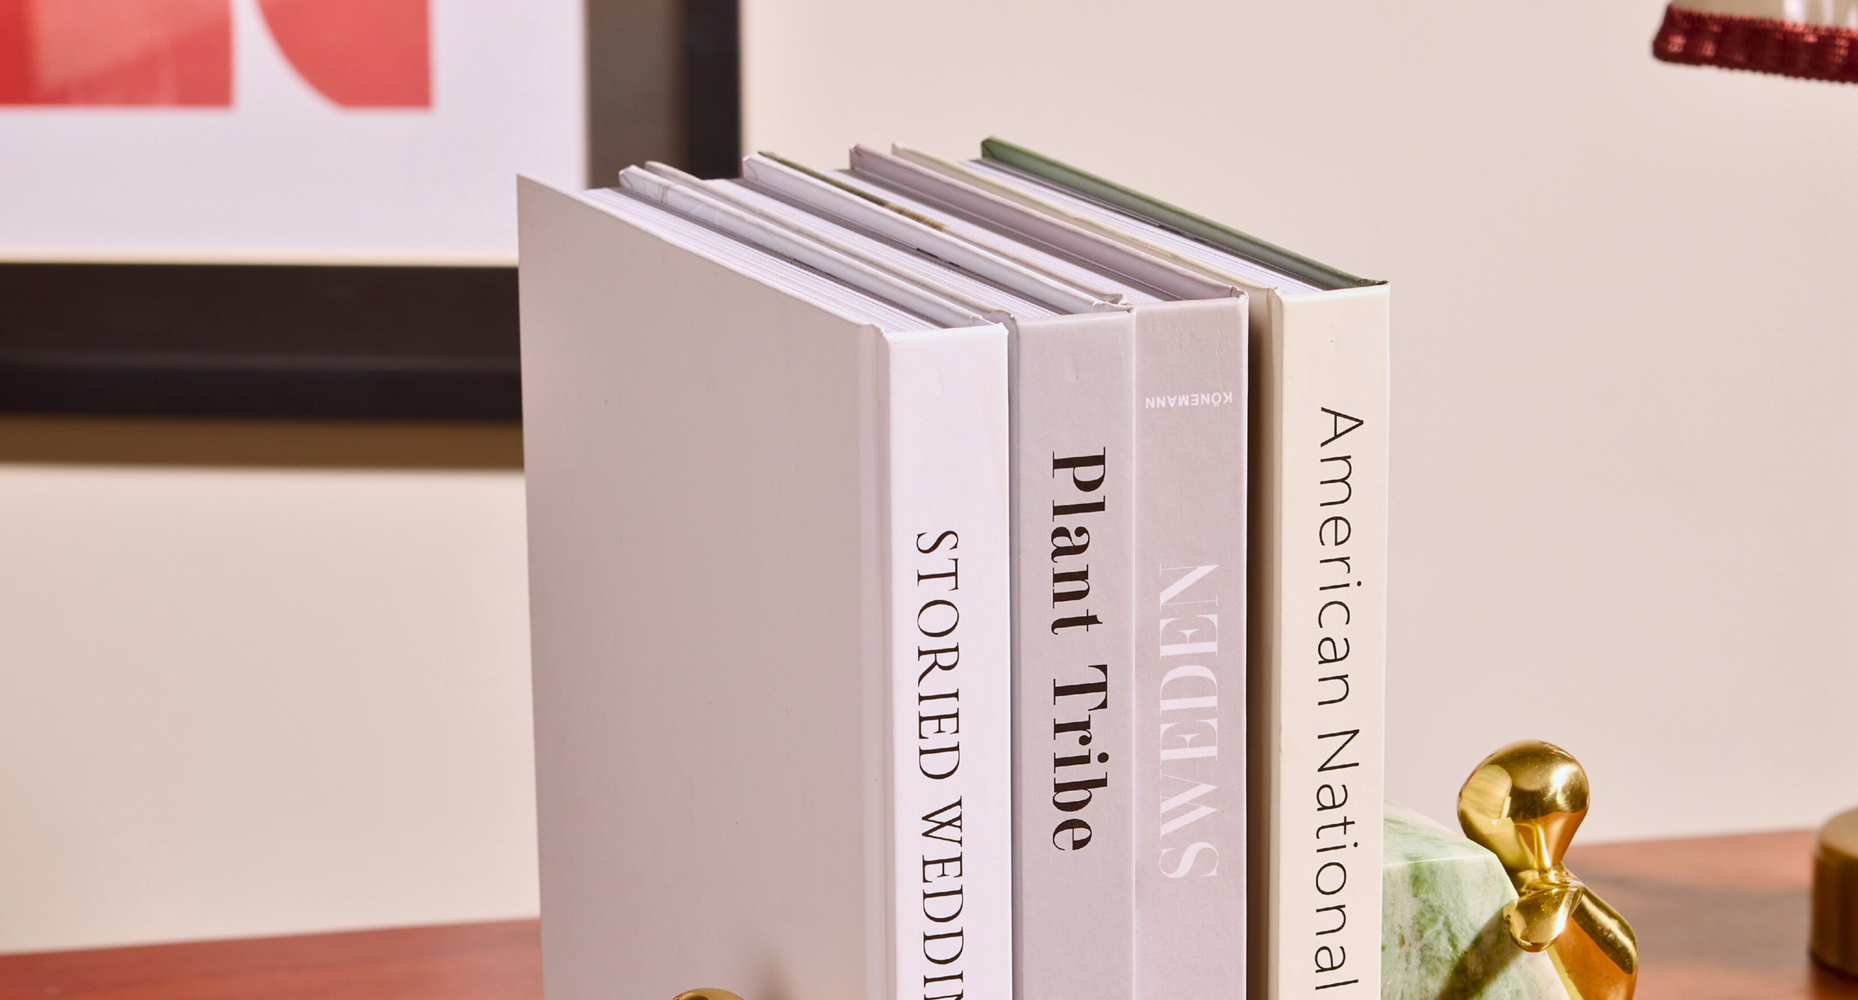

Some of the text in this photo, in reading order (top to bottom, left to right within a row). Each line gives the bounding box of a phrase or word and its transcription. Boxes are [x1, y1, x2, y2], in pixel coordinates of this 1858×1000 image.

[1145, 391, 1233, 409] KÖNEMANN
[915, 530, 961, 780] STORIED
[1050, 446, 1109, 851] Plant Tribe
[1317, 406, 1365, 707] American
[1158, 563, 1220, 879] SWEDEN
[1314, 728, 1360, 991] National
